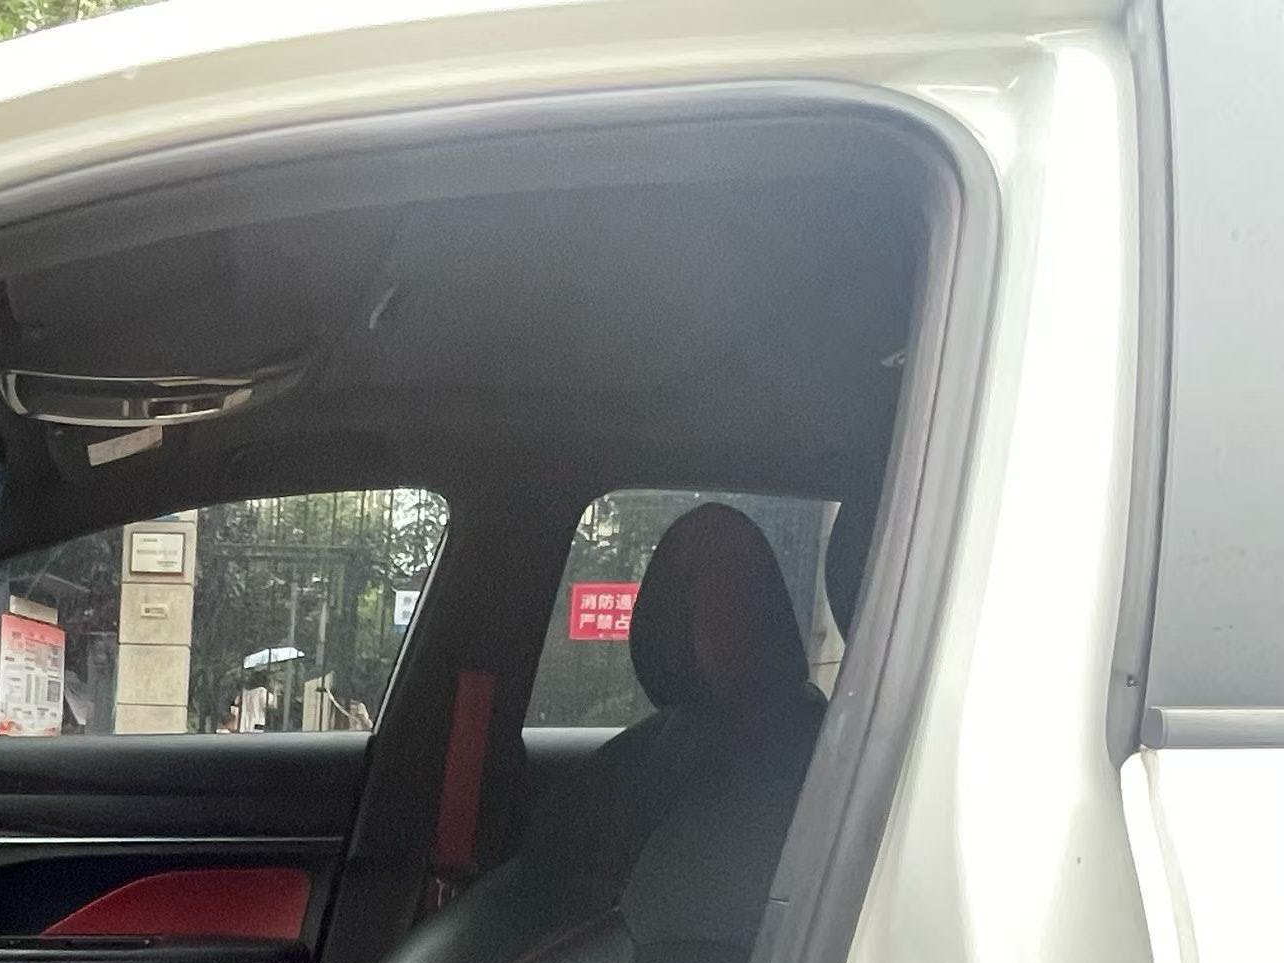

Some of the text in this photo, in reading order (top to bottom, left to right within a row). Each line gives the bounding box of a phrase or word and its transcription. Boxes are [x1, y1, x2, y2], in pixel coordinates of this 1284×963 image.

[579, 593, 637, 610] 消防通
[579, 612, 632, 630] 严禁占
